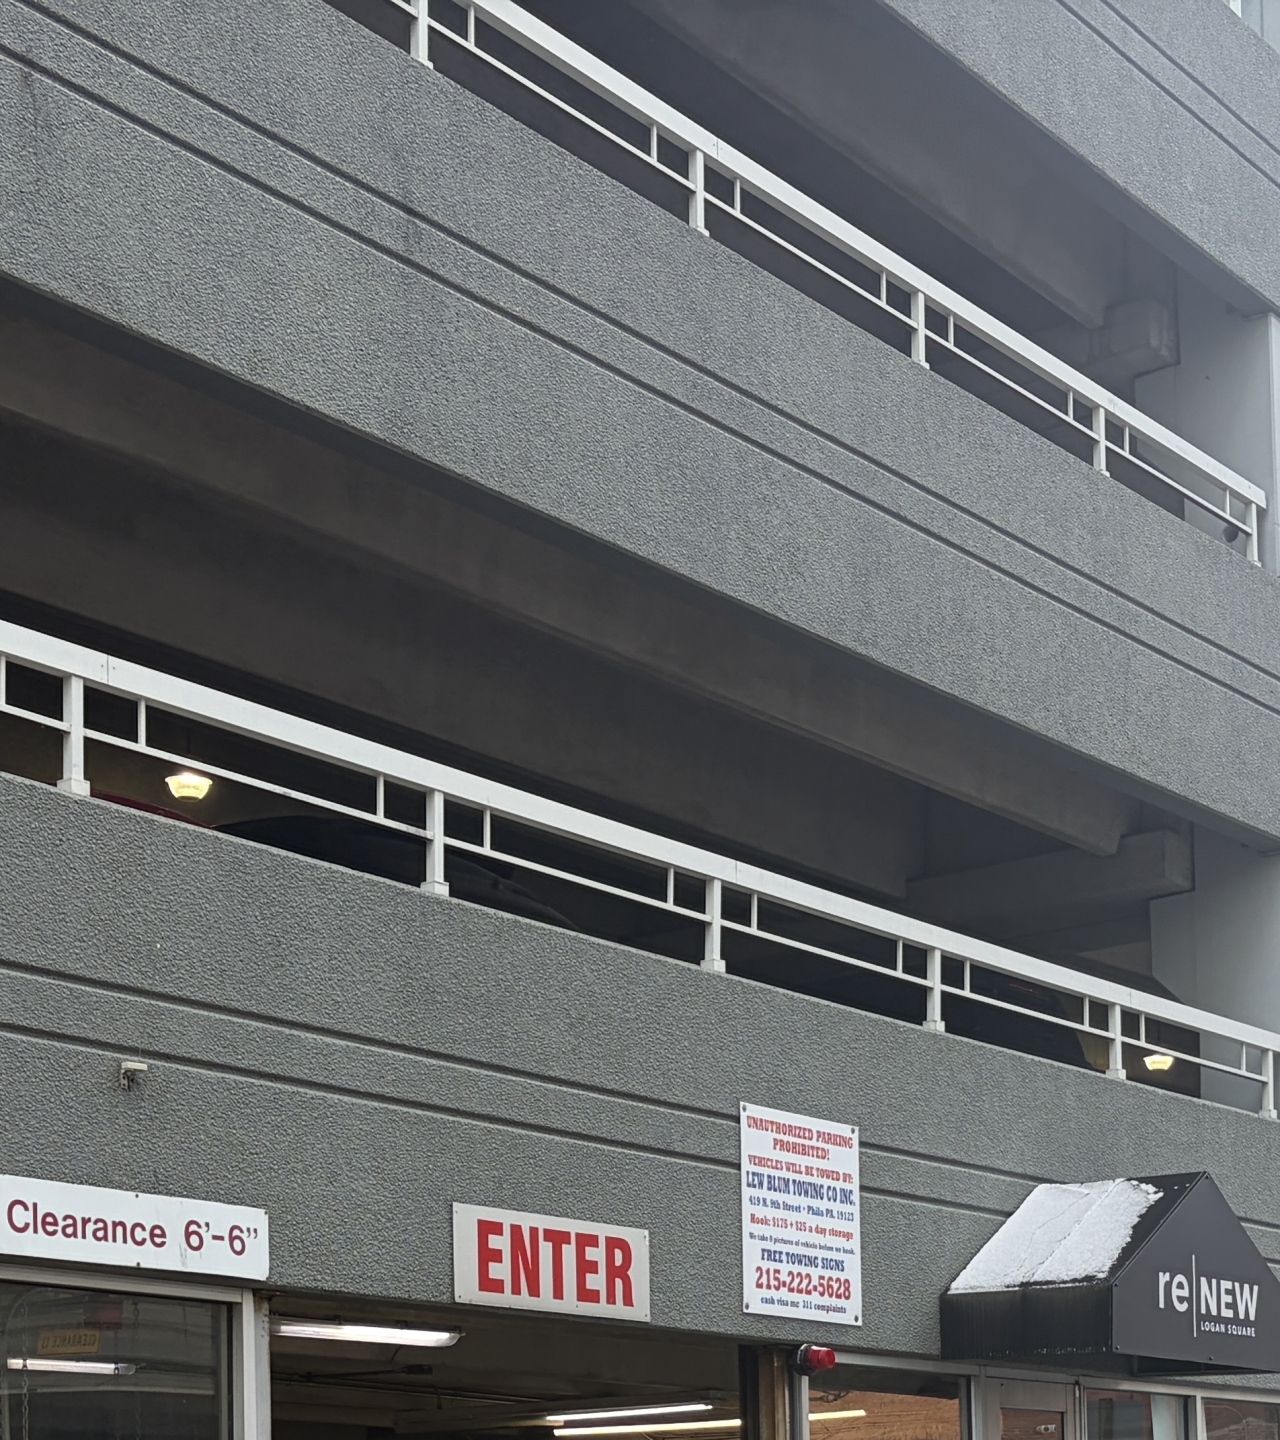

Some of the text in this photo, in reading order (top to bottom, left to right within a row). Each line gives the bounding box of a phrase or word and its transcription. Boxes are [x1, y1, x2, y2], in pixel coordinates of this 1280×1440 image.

[746, 1115, 853, 1149] UNAUTHORIZED PARKING
[773, 1138, 830, 1161] PROHIBITED!
[748, 1154, 853, 1184] VEHICLES WILL BE TOWED BY:
[746, 1171, 855, 1206] LEW BLUM TOWING CO INC.
[749, 1195, 854, 1222] 419 N. 9th Street Phila PA. 19123
[7, 1199, 167, 1249] Clearance
[750, 1213, 771, 1226] Hook:
[772, 1216, 788, 1228] $175
[795, 1220, 806, 1232] $25
[808, 1225, 813, 1233] a
[815, 1224, 827, 1238] day
[829, 1227, 853, 1242] storage
[477, 1218, 634, 1308] ENTER
[761, 1248, 845, 1272] FREE TOWING SIGNS
[755, 1266, 851, 1300] 215-222-5628
[761, 1296, 775, 1304] cash
[777, 1297, 789, 1306] visa
[803, 1300, 812, 1310] 311
[814, 1303, 846, 1314] complaints
[1201, 1321, 1255, 1337] LOGAN SQUARE
